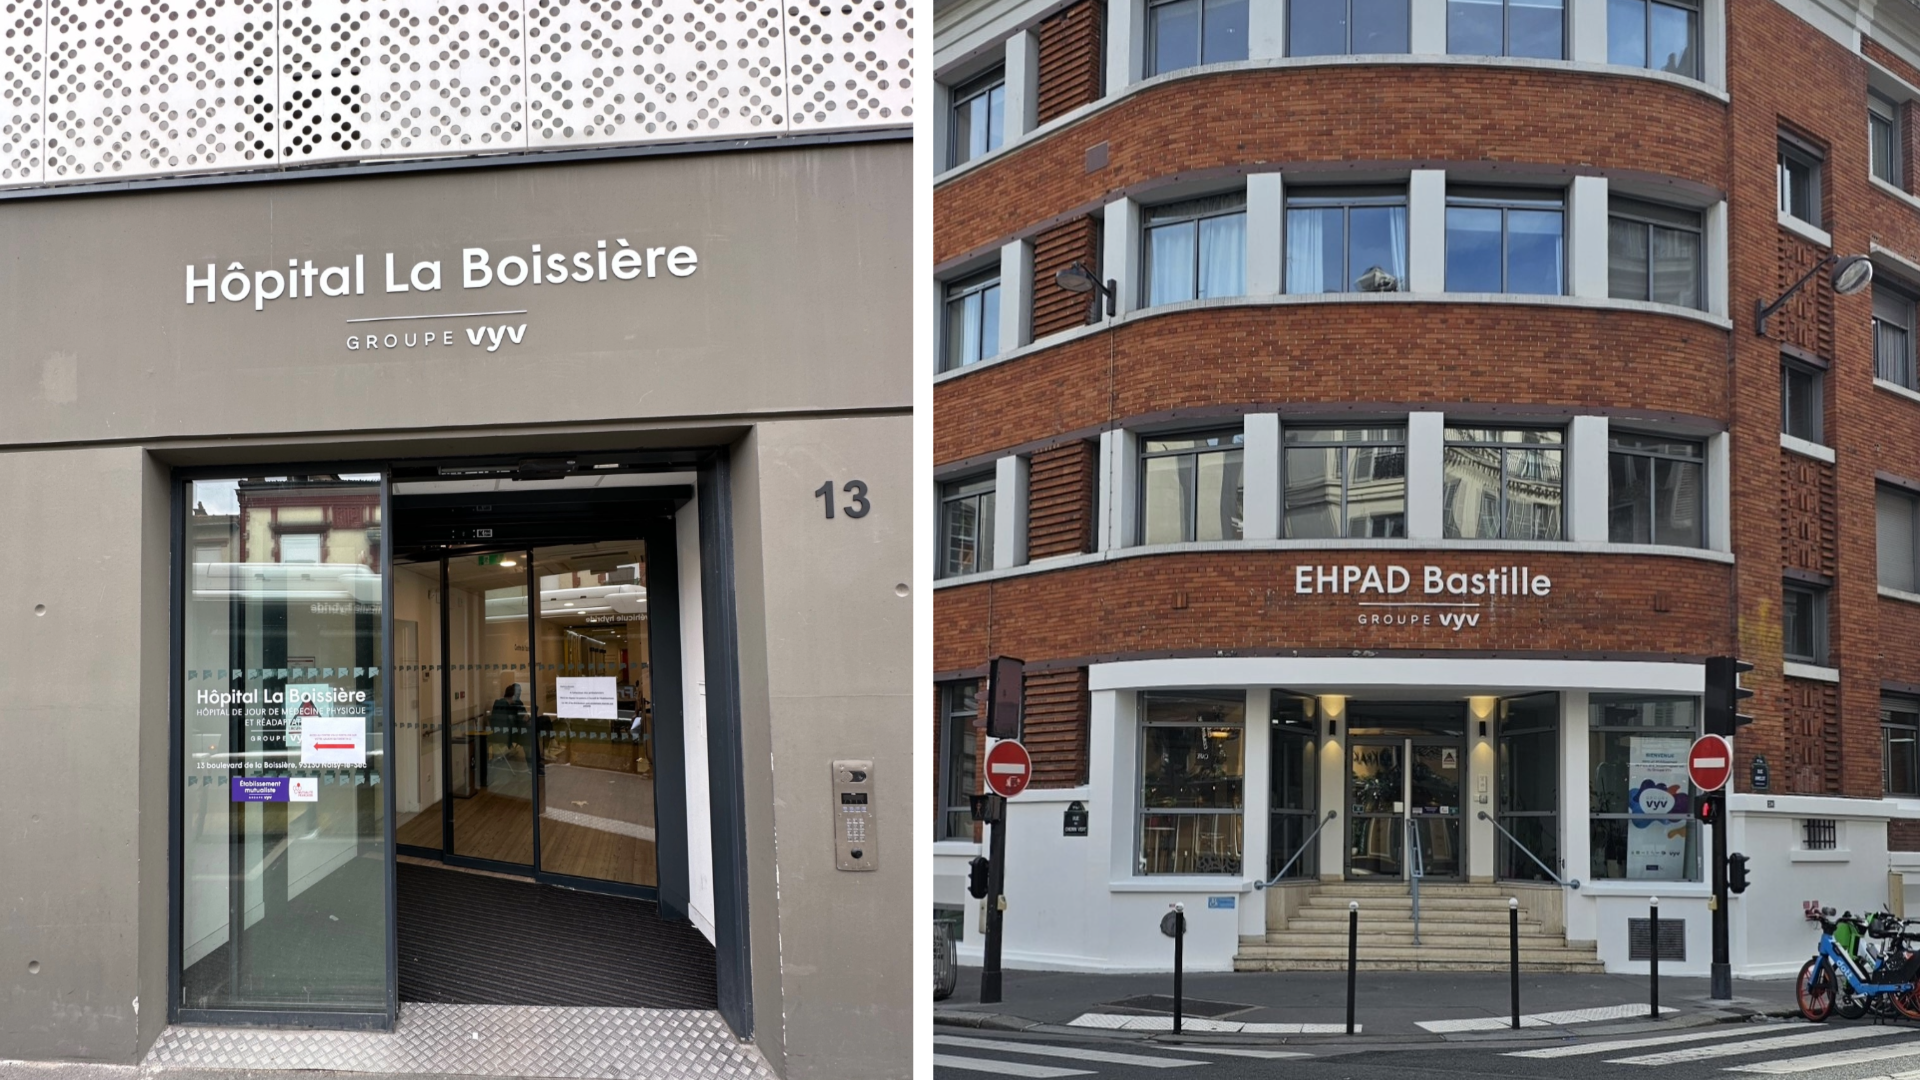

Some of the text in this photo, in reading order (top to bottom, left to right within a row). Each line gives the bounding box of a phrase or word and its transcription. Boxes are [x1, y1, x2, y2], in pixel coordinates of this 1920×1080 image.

[185, 239, 699, 310] Hôpital La Boissière
[346, 323, 528, 351] GROUPE vyv
[815, 479, 871, 519] 13
[1295, 565, 1552, 596] EHPAD Bastille
[1358, 612, 1480, 631] GROUPE vyv
[197, 687, 366, 708] Hôpital La Boissière
[196, 706, 366, 716] HÔPITAL DE JOUR DE MÉDECINE PHYSIQUE
[290, 735, 302, 744] vy
[196, 761, 205, 769] 13
[206, 761, 243, 769] boulevard
[244, 761, 253, 769] de
[254, 761, 262, 769] la
[263, 760, 298, 770] Boissière,
[239, 779, 281, 787] Établissement
[244, 786, 276, 794] mutualiste
[1646, 800, 1668, 811] vyv
[1836, 959, 1854, 980] dott
